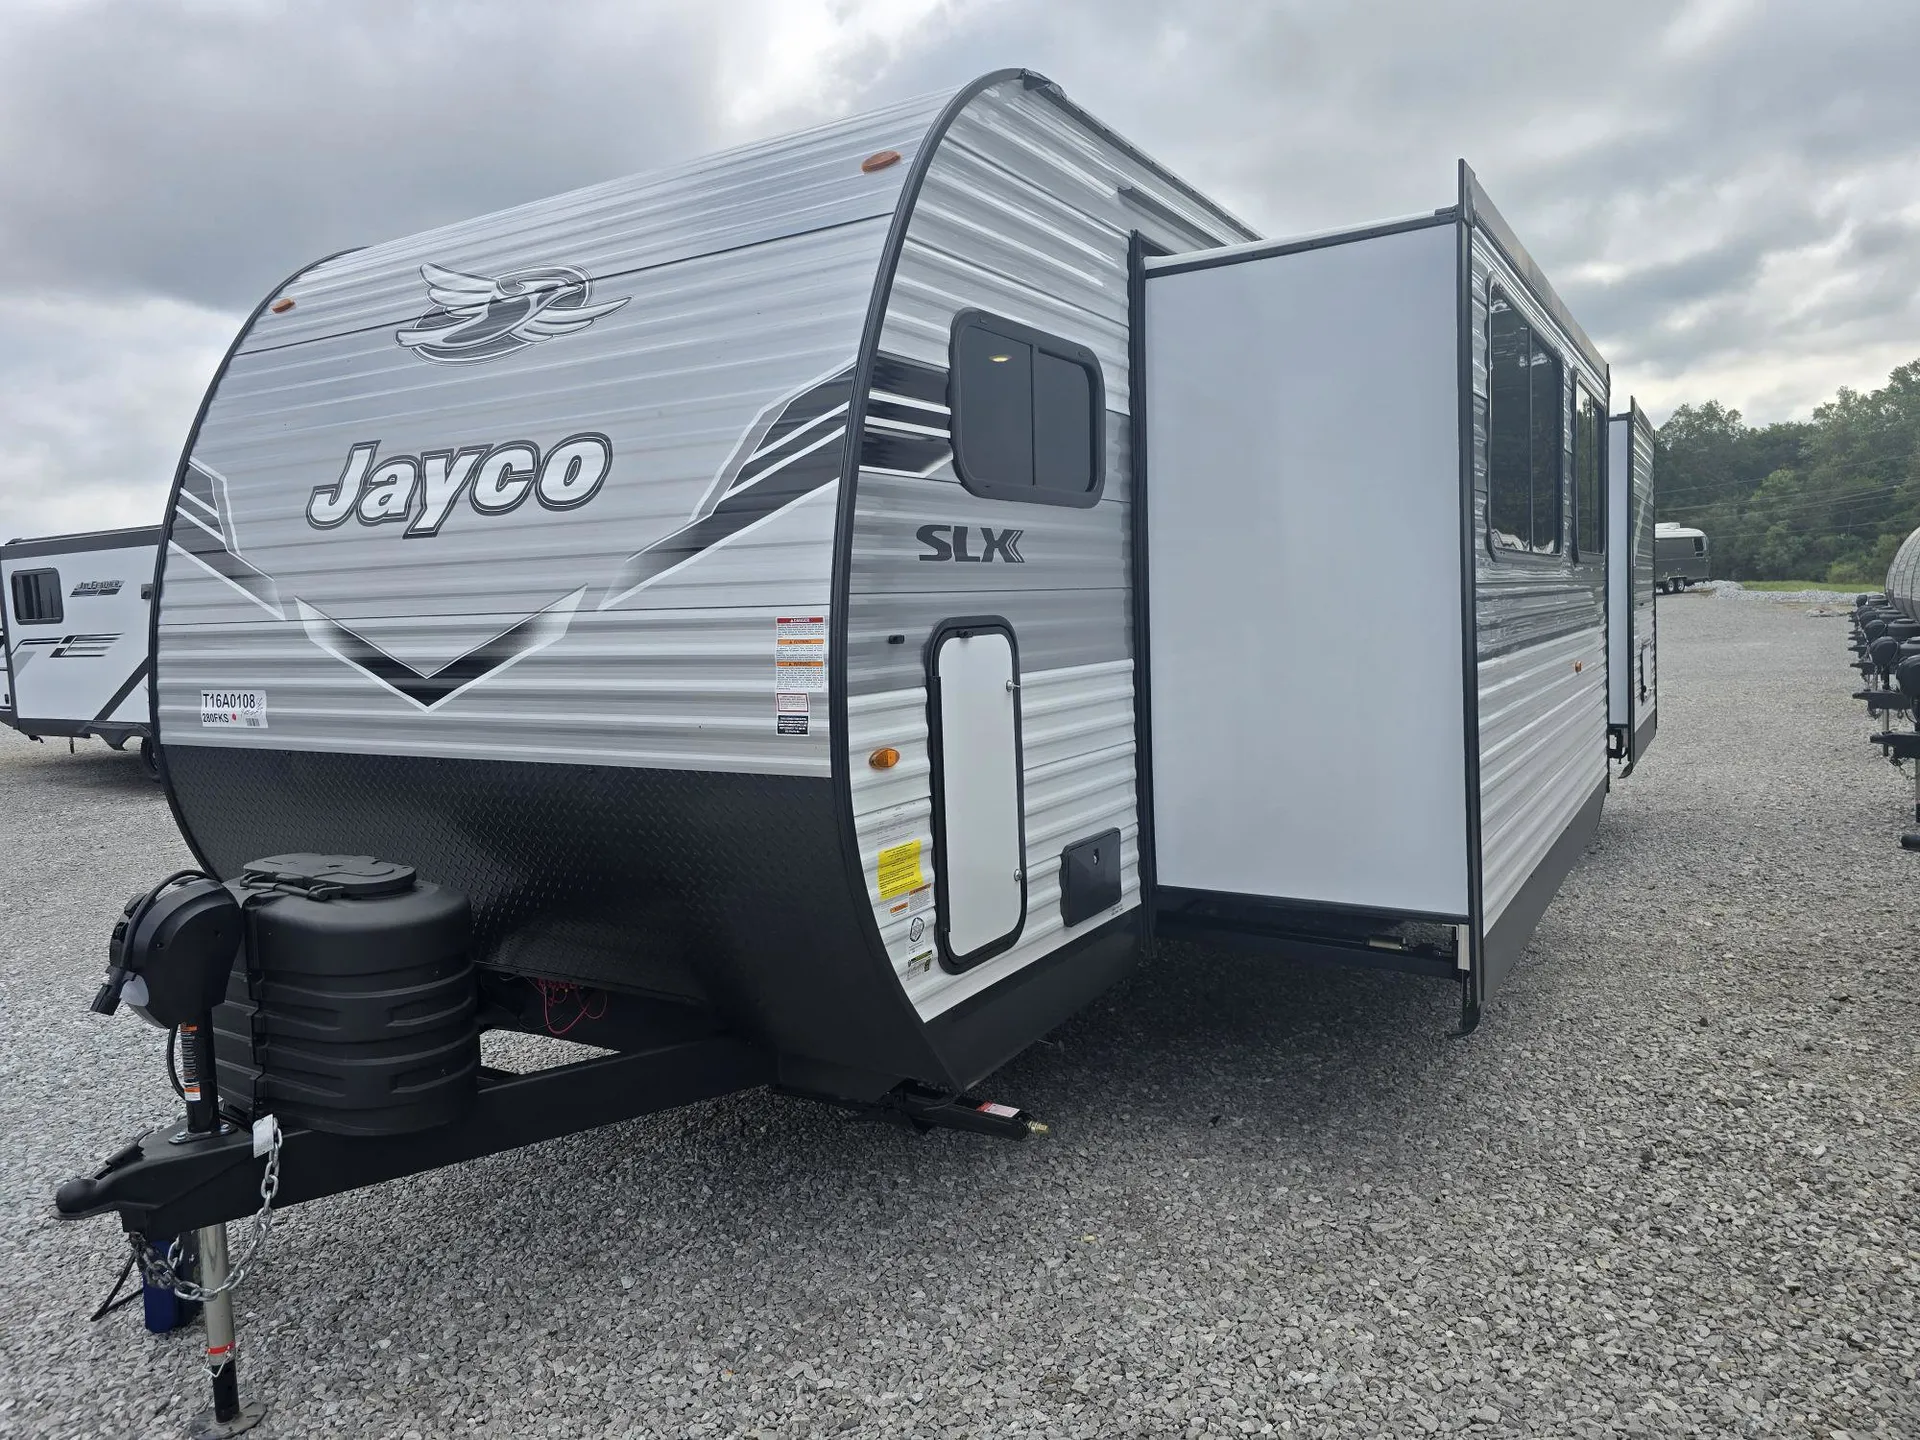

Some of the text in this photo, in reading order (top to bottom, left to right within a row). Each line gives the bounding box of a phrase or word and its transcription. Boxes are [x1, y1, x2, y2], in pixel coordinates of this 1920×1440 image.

[306, 431, 612, 539] Jayco
[916, 524, 1025, 563] SLX
[203, 694, 255, 708] T16A0108
